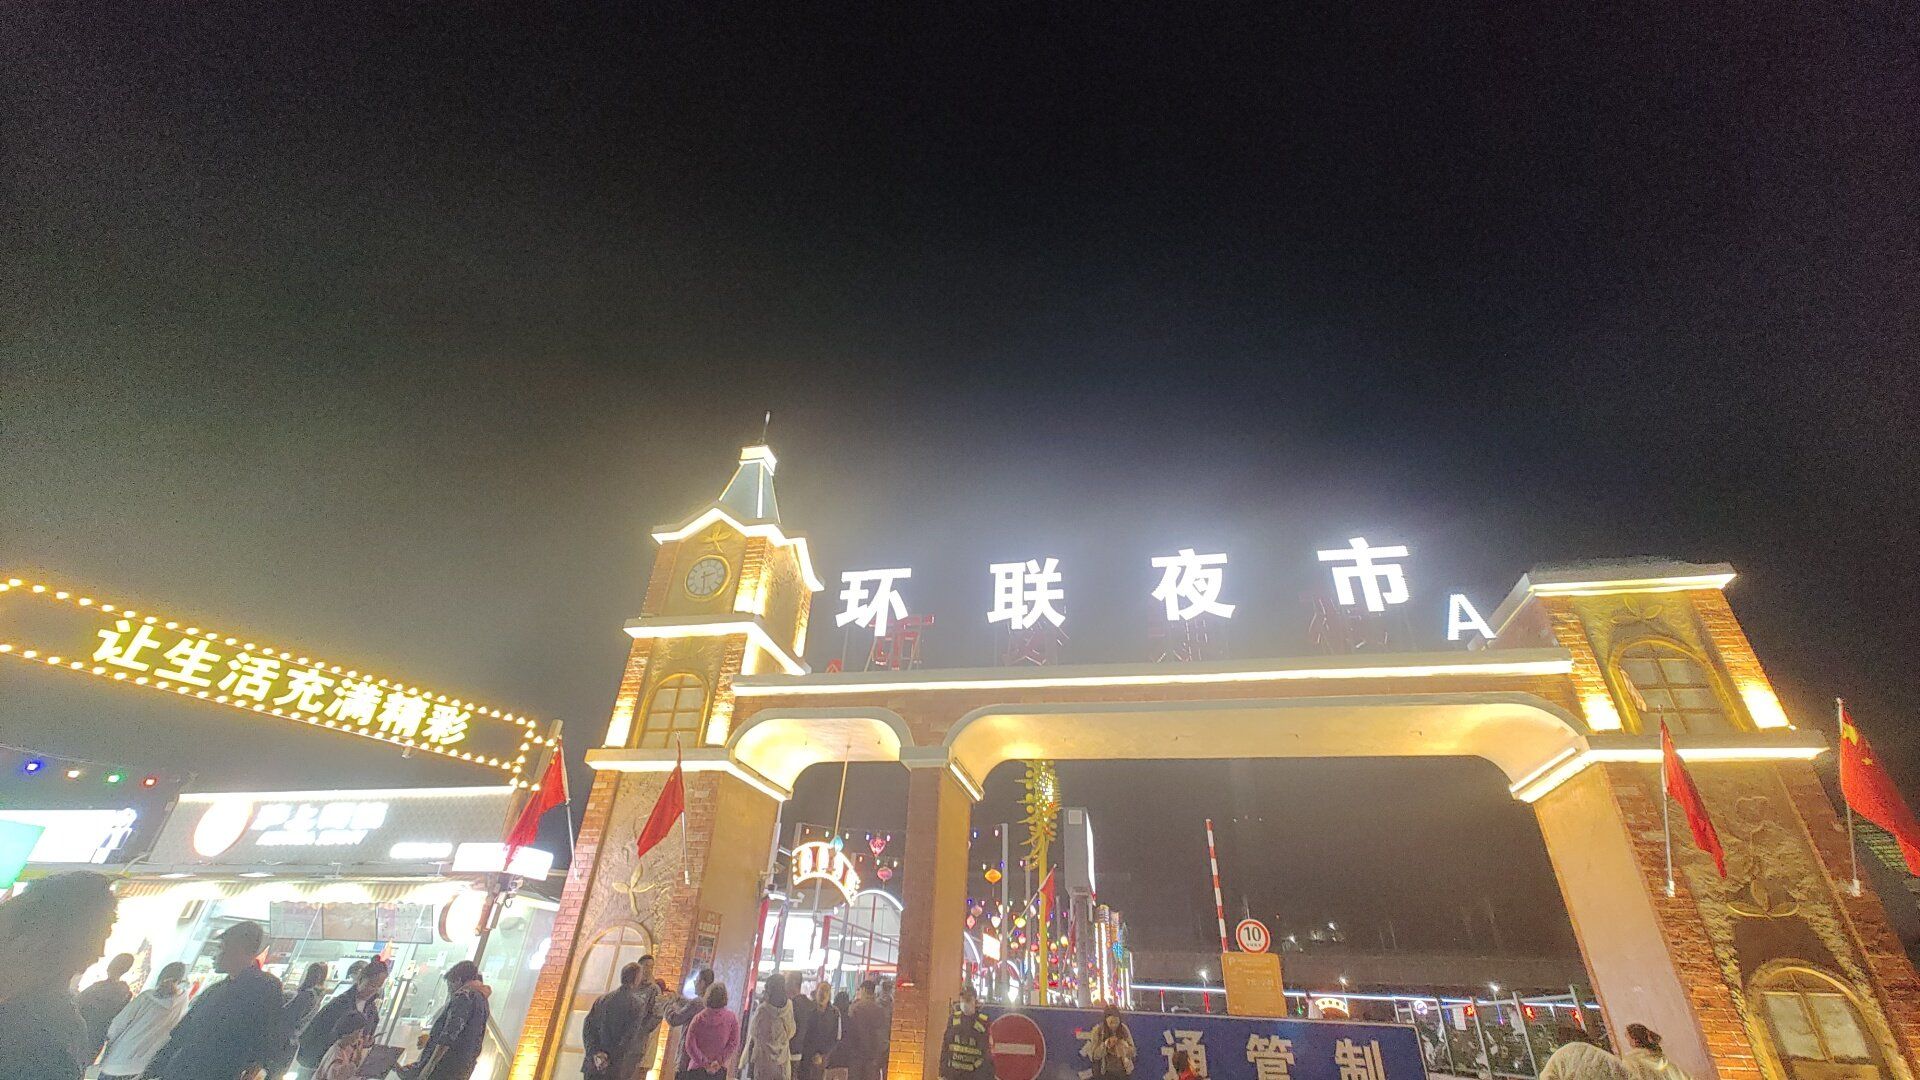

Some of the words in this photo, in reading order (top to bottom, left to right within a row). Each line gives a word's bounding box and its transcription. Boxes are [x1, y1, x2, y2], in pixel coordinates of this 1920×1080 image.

[835, 537, 1411, 637] 环联夜市
[92, 619, 472, 745] 让生活充满精彩
[1243, 926, 1262, 942] 10
